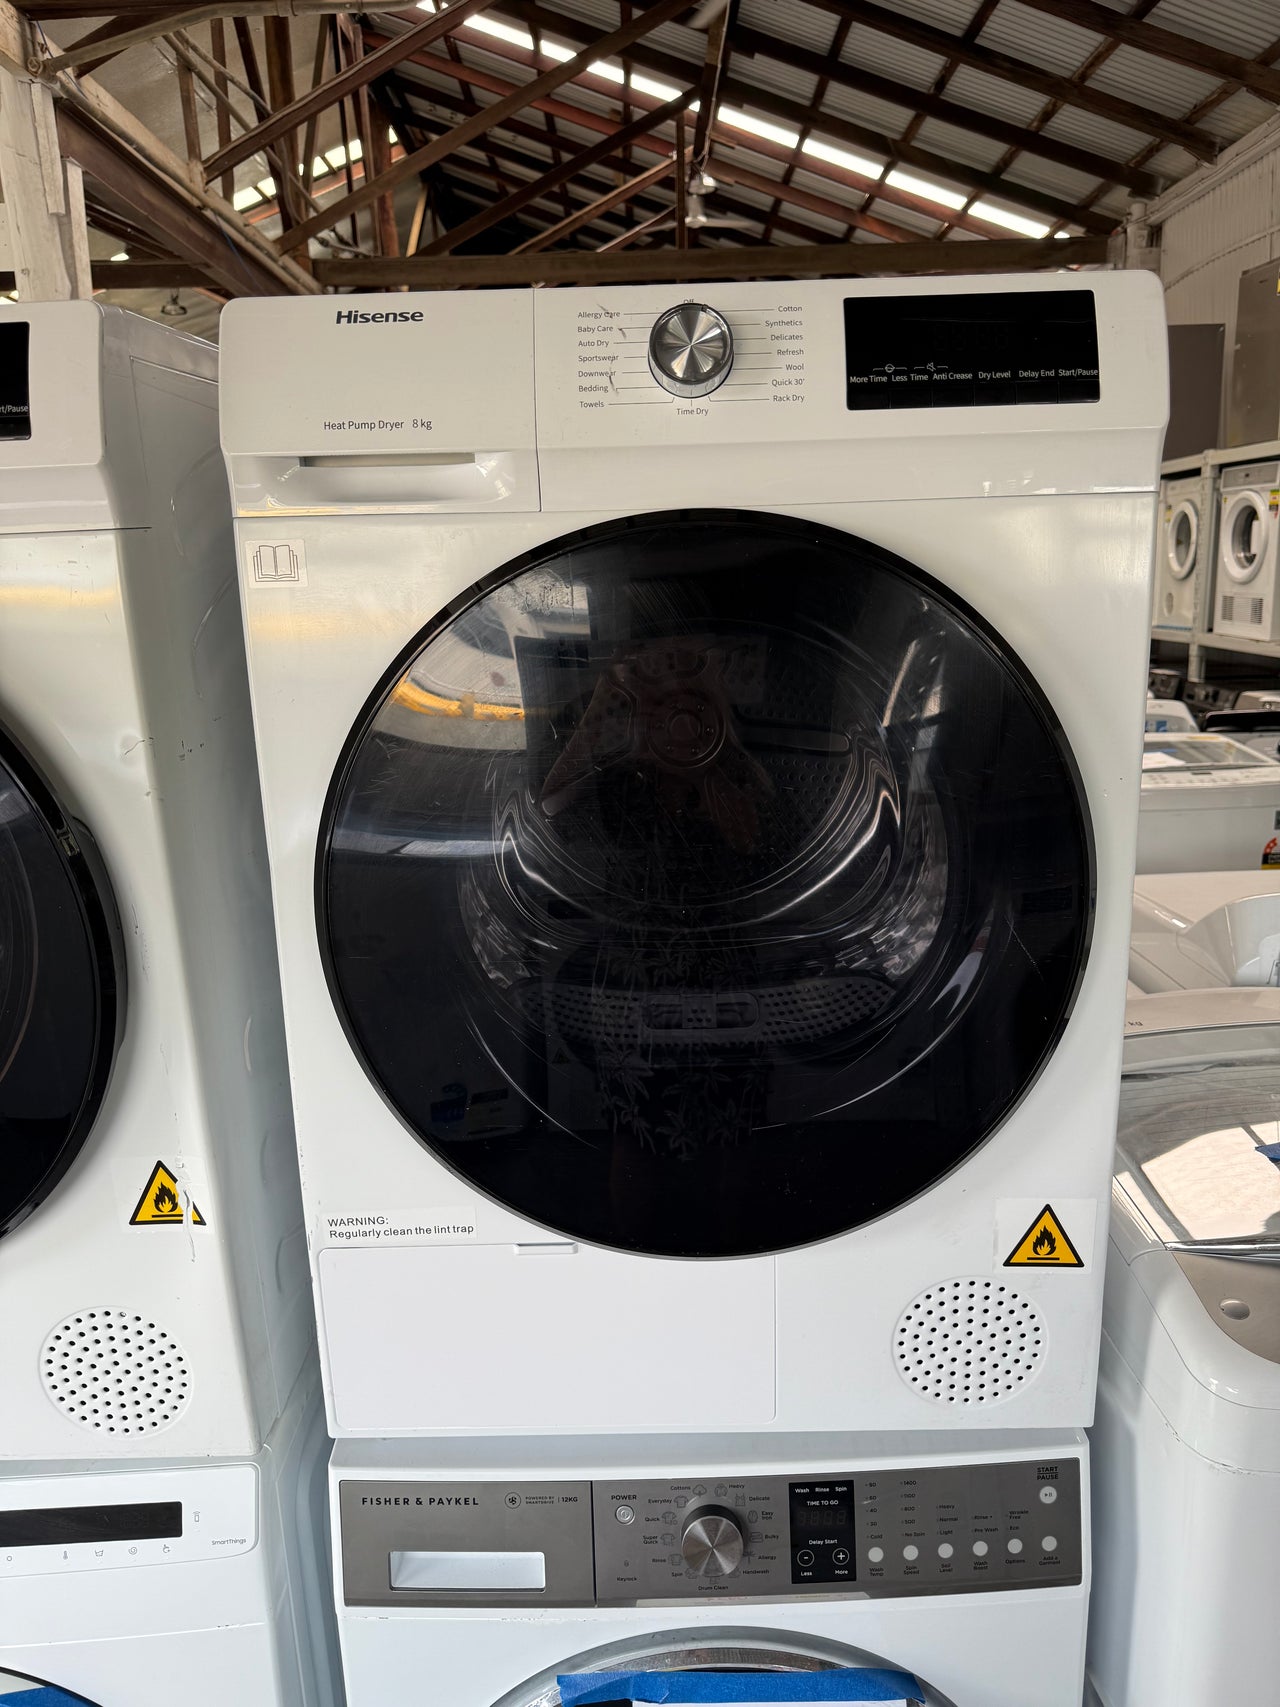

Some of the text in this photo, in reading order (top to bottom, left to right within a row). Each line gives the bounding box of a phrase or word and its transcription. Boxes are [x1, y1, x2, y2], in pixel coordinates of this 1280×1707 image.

[336, 310, 424, 324] Hisense
[597, 340, 609, 348] Dry
[578, 354, 618, 363] Sportswear
[979, 371, 991, 380] Dry
[1019, 370, 1038, 378] Delay
[1058, 369, 1098, 377] Start/Pause
[579, 385, 608, 393] Bedding
[792, 394, 805, 403] Dry
[695, 408, 708, 416] Dry
[324, 419, 432, 431] Heat Pump Dryer 8 kg
[328, 1216, 388, 1227] WARNING:
[330, 1224, 474, 1239] Regularly clean the lint trap
[362, 1497, 479, 1505] FISHER & PAYKEL
